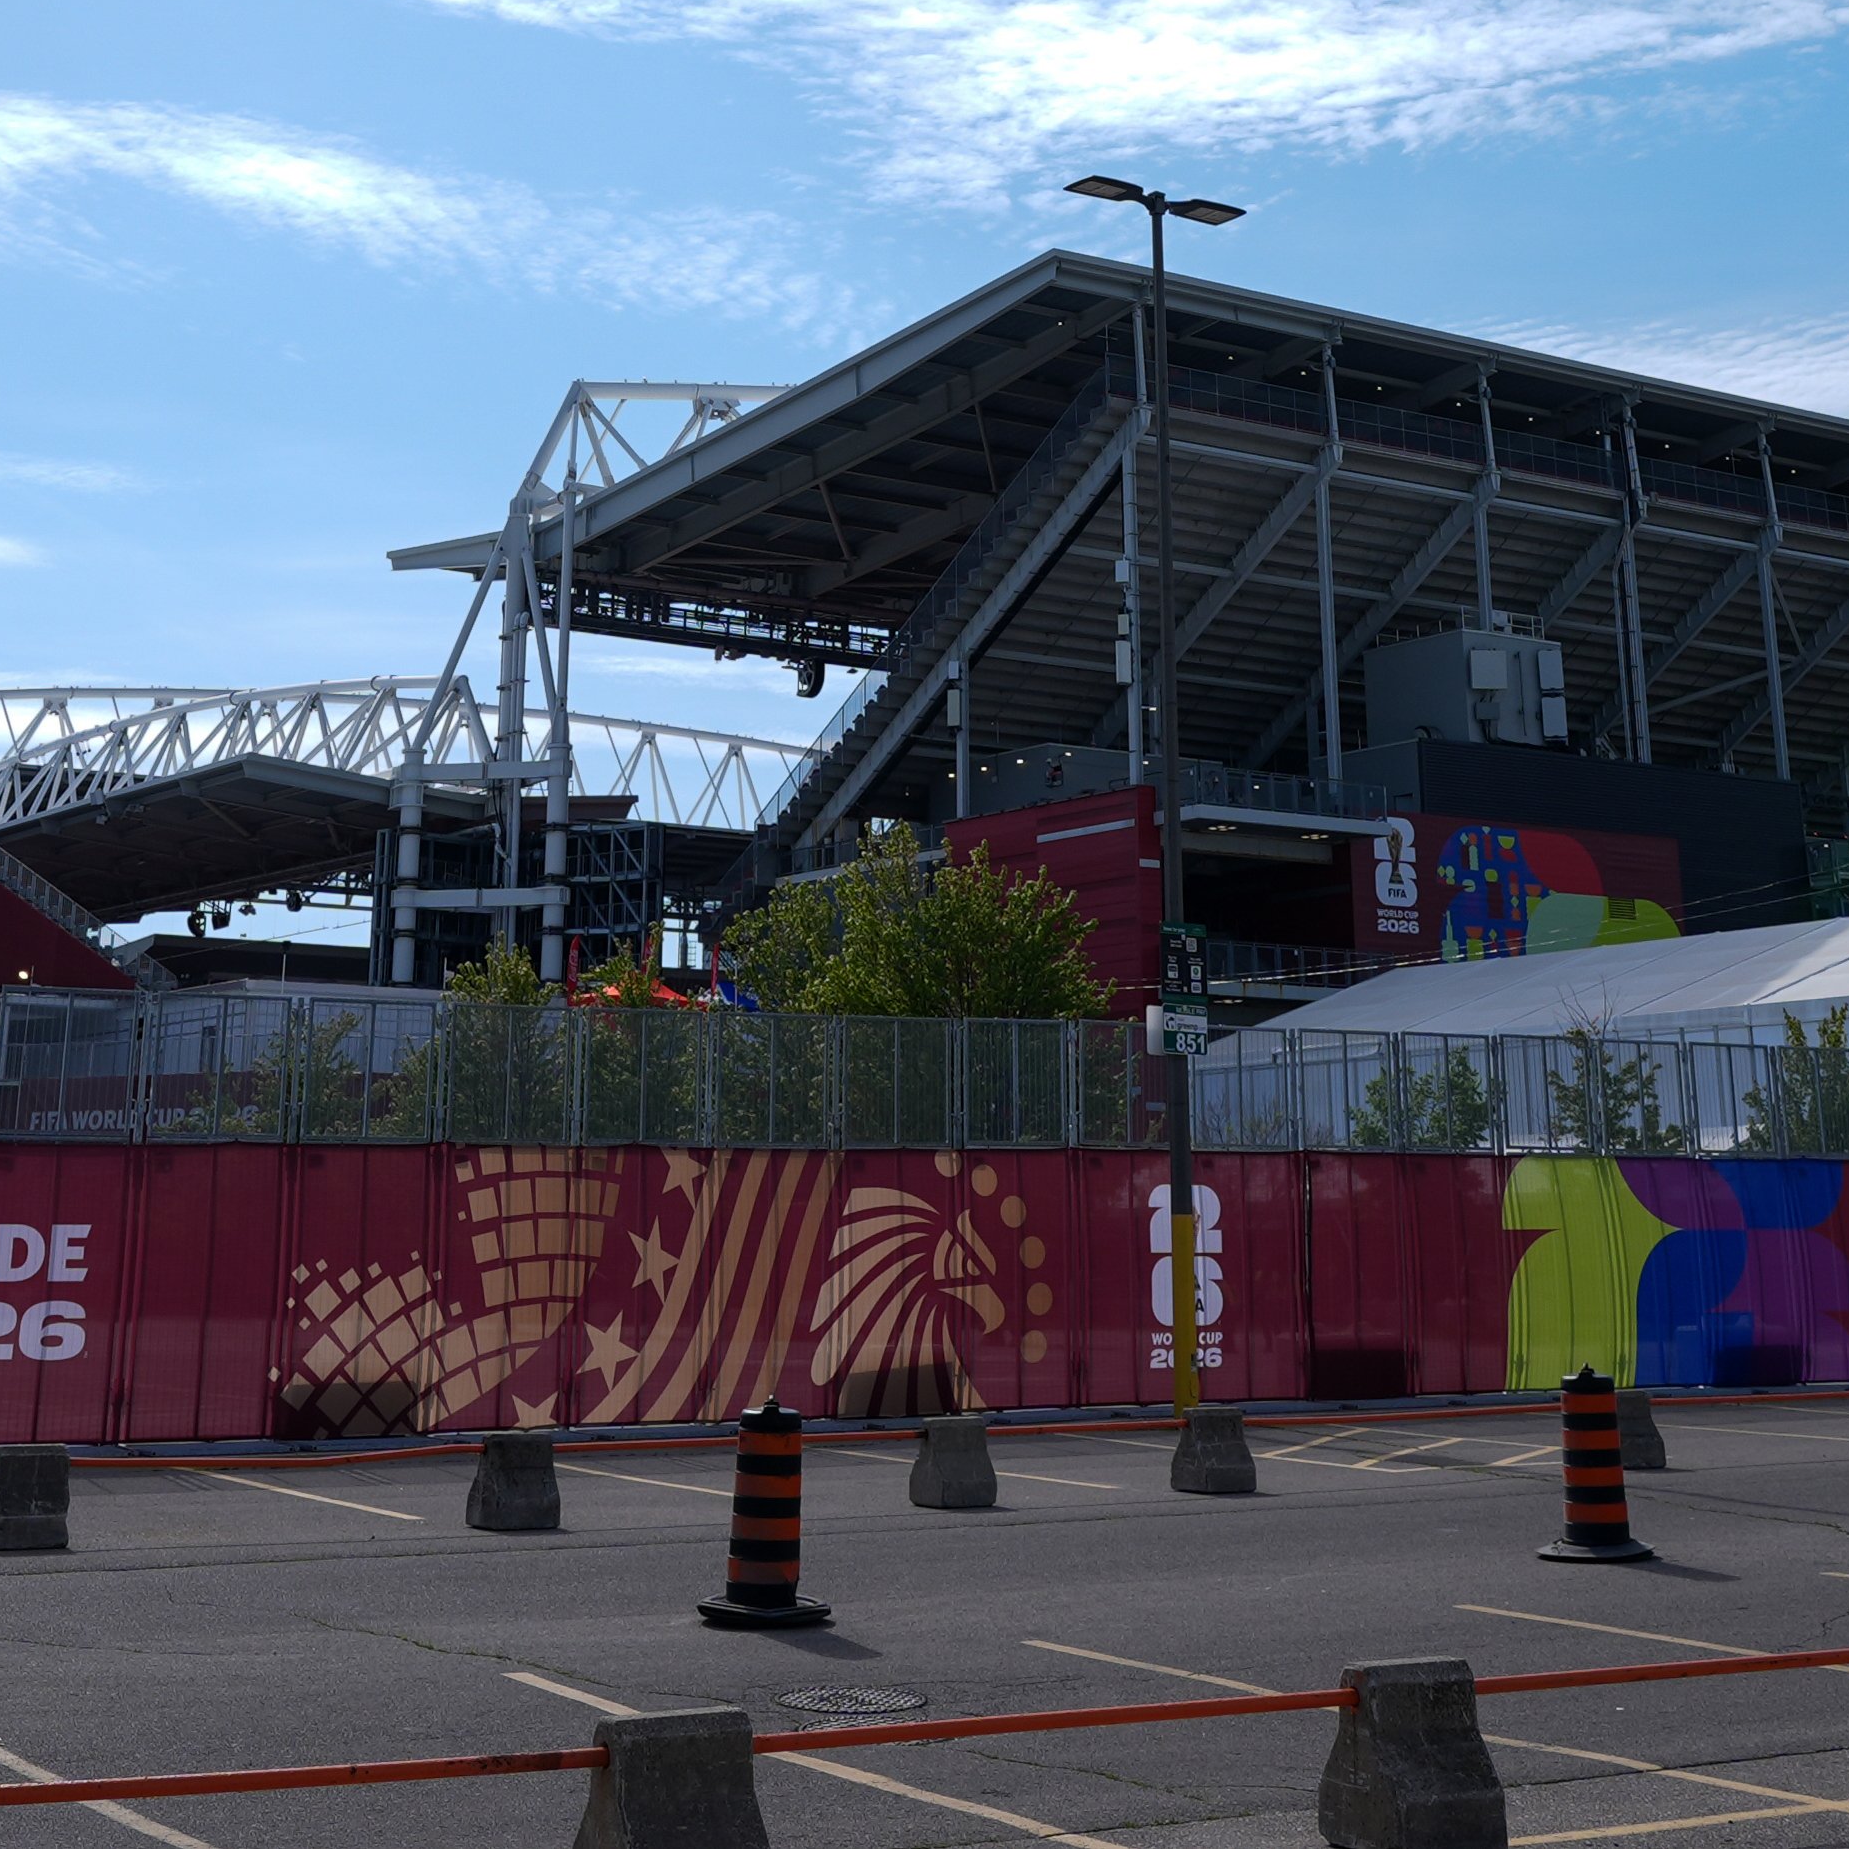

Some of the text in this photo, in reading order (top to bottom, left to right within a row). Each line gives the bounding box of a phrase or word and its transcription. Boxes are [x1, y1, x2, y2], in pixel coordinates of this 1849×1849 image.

[1388, 888, 1408, 899] FIFA
[1376, 909, 1420, 919] WORLD CUP
[1376, 919, 1420, 935] 2026
[1176, 1032, 1205, 1054] 851
[1198, 1331, 1224, 1346] CUP
